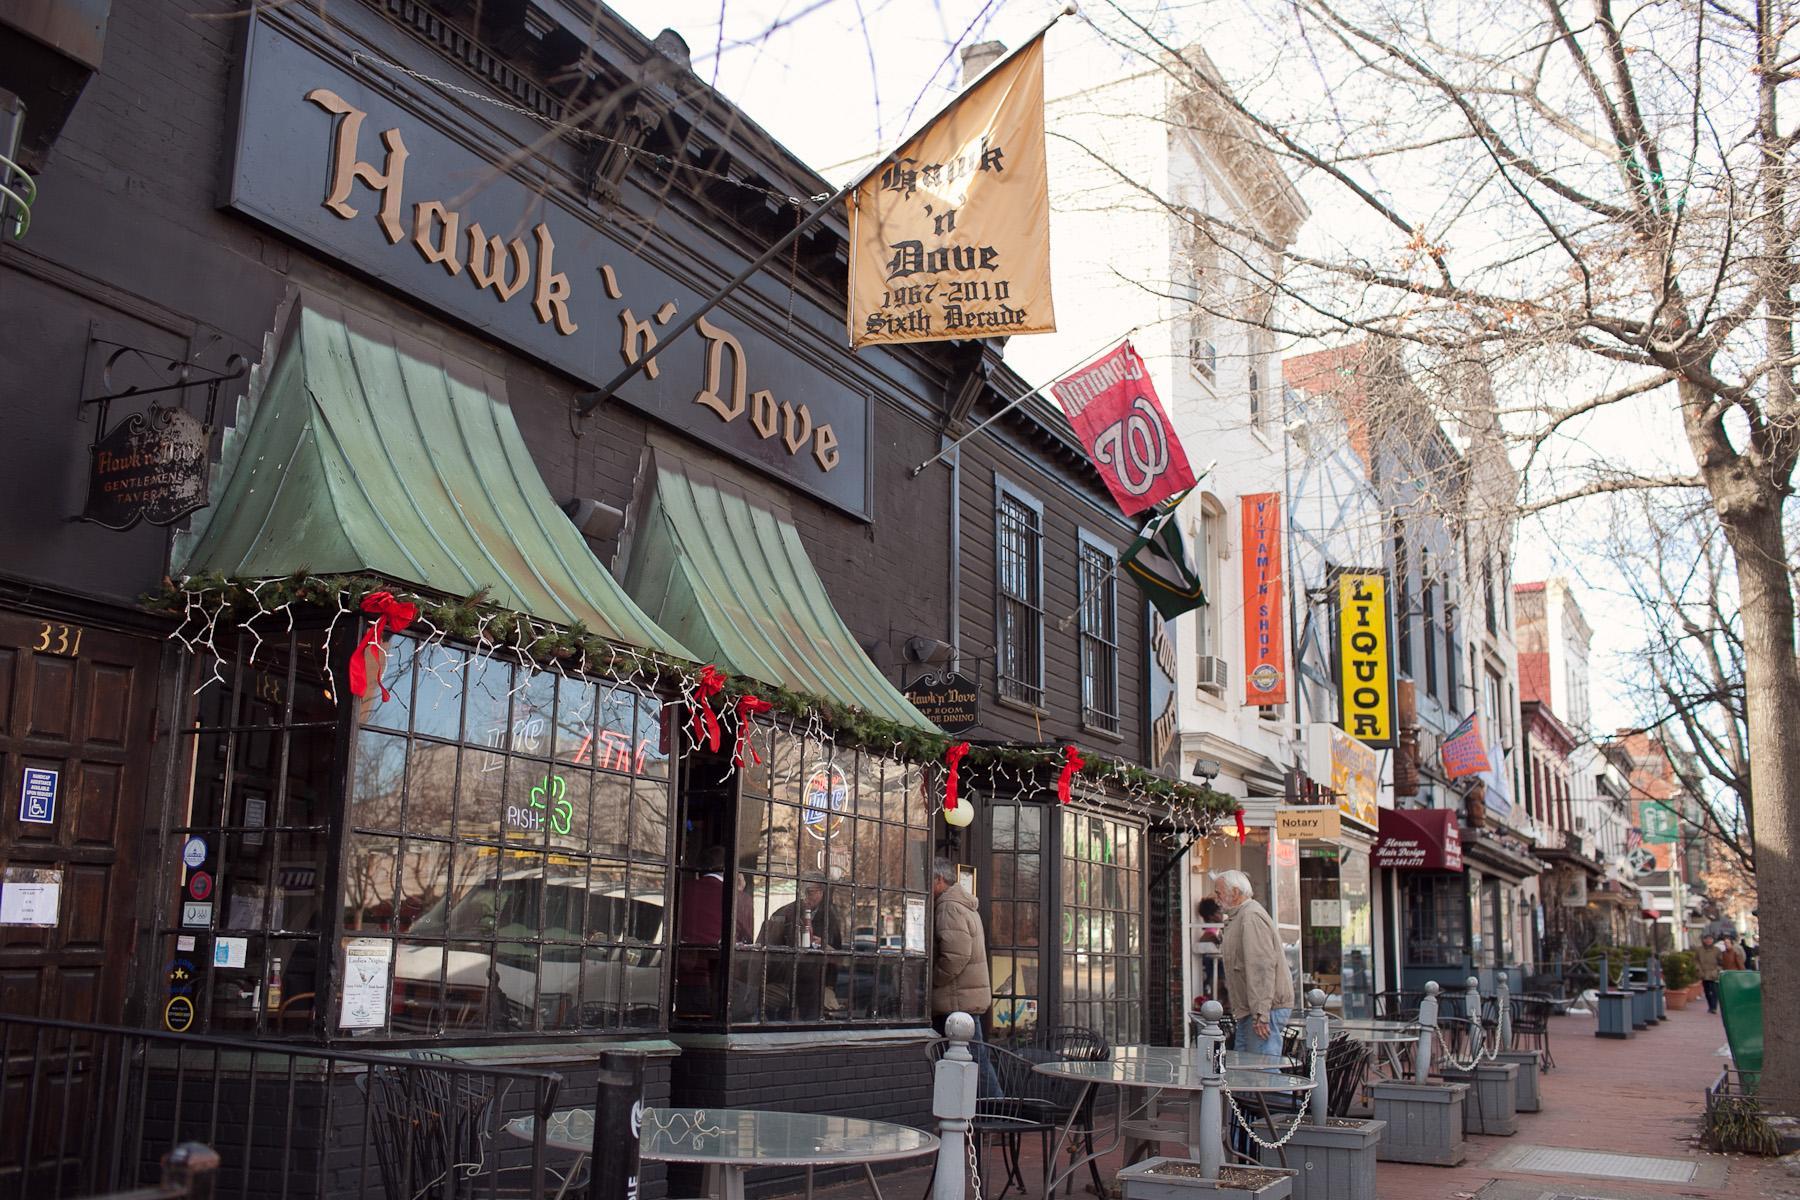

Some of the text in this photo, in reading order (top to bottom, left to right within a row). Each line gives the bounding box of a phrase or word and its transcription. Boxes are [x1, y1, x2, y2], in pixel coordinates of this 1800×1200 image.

[881, 136, 1005, 201] Hawk
[886, 239, 1000, 283] Dove
[303, 88, 578, 336] Hawk
[694, 315, 840, 473] Dove
[882, 280, 1010, 309] 1967-2010
[865, 303, 1028, 336] Sixth Decade
[1054, 340, 1144, 418] NATIONALS
[32, 622, 83, 657] 331
[1259, 604, 1269, 660] SHOP
[1351, 578, 1382, 737] LIQUOR
[934, 707, 963, 715] ROOM
[948, 689, 977, 703] Dove
[943, 714, 975, 723] DINING
[1282, 819, 1318, 828] Notary
[1376, 847, 1426, 858] Hair Design
[1384, 838, 1418, 848] Florence
